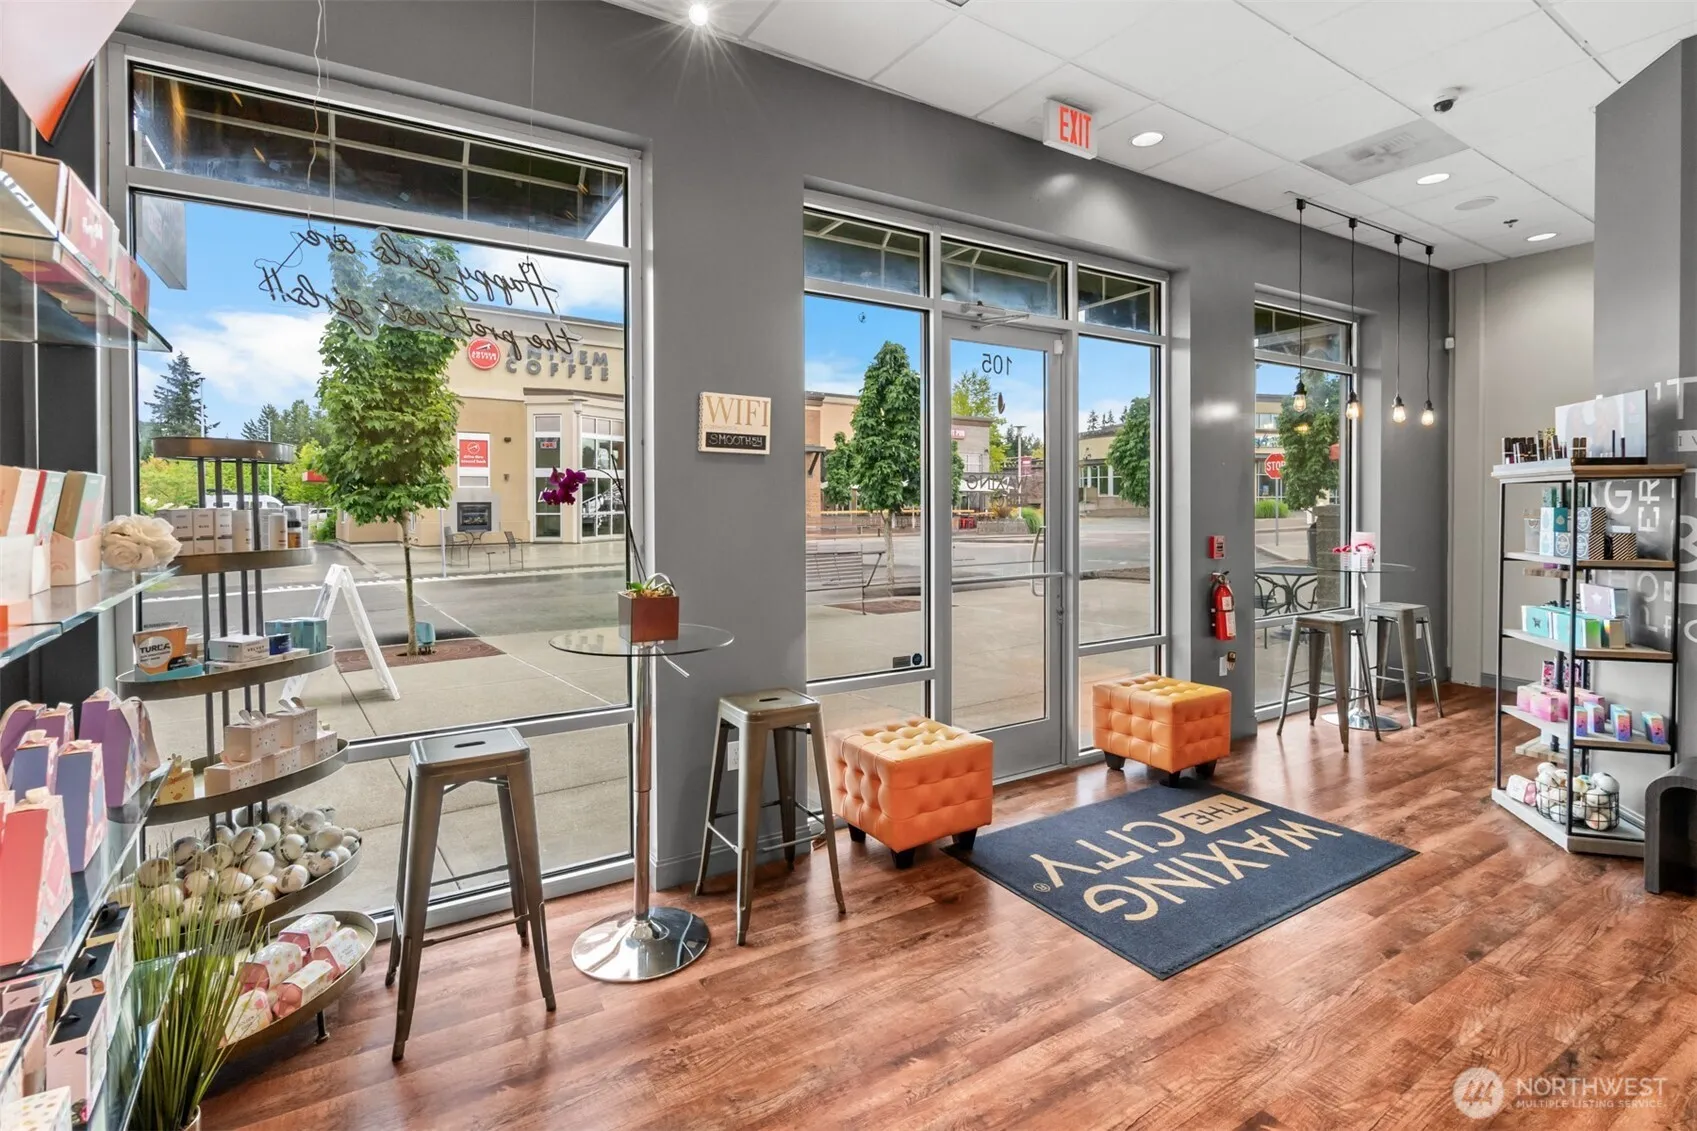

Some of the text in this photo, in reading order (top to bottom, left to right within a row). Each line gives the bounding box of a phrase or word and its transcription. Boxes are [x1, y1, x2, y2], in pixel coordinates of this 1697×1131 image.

[1059, 105, 1092, 149] EXIT
[505, 358, 609, 382] COFFEE
[704, 395, 770, 428] WIFI
[1029, 802, 1249, 888] THE CITY
[1083, 818, 1344, 922] WAXING
